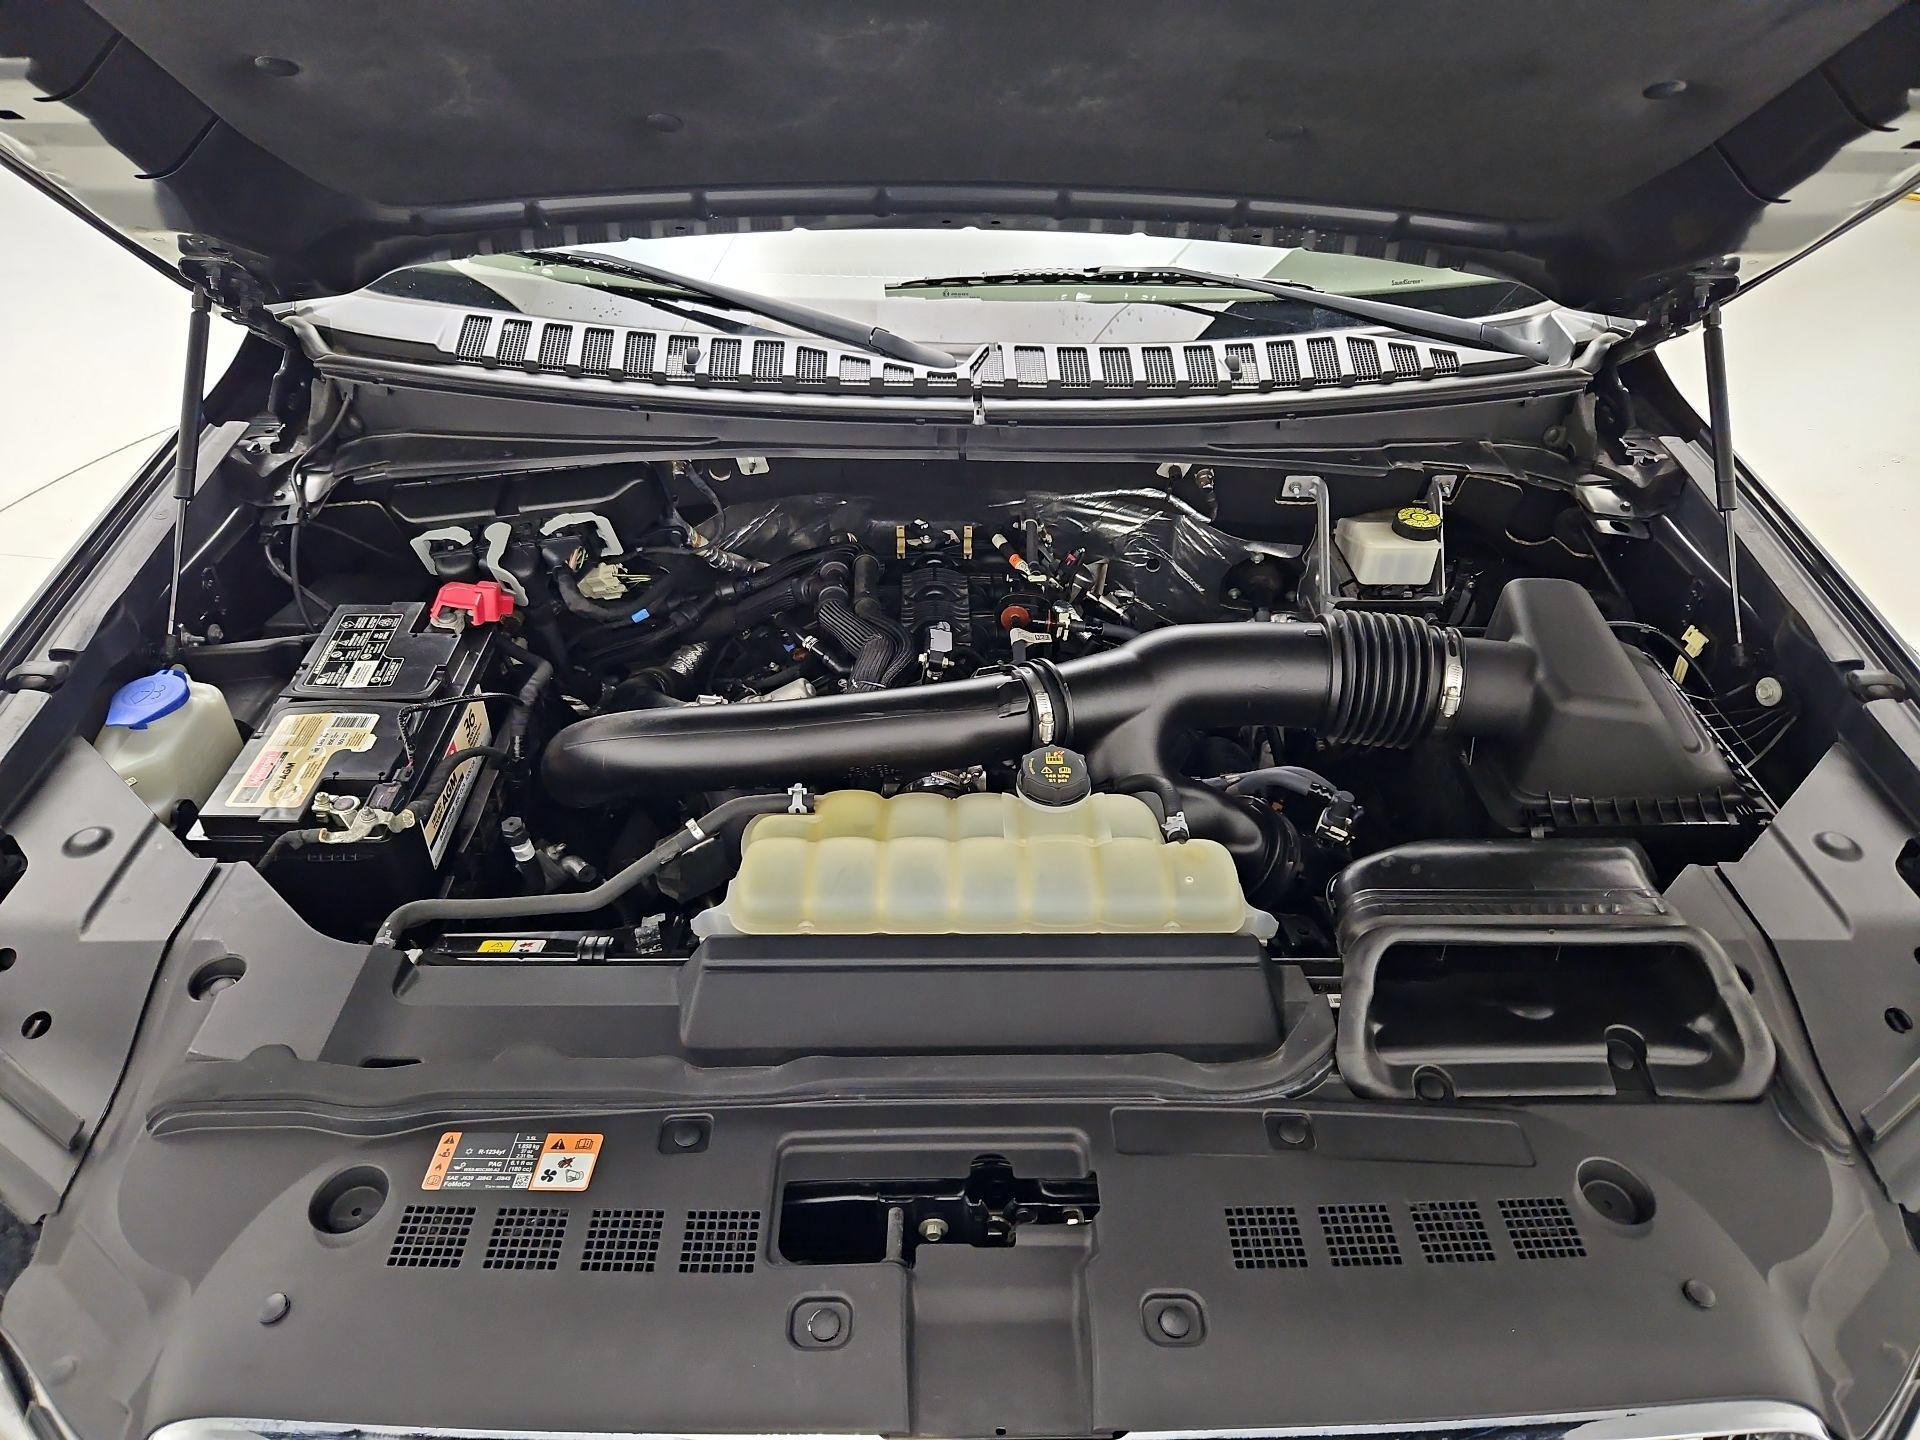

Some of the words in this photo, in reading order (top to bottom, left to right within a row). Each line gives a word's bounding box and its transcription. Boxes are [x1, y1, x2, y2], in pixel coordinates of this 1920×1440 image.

[464, 709, 475, 738] 36
[279, 762, 296, 779] AGM
[443, 771, 457, 809] AGM
